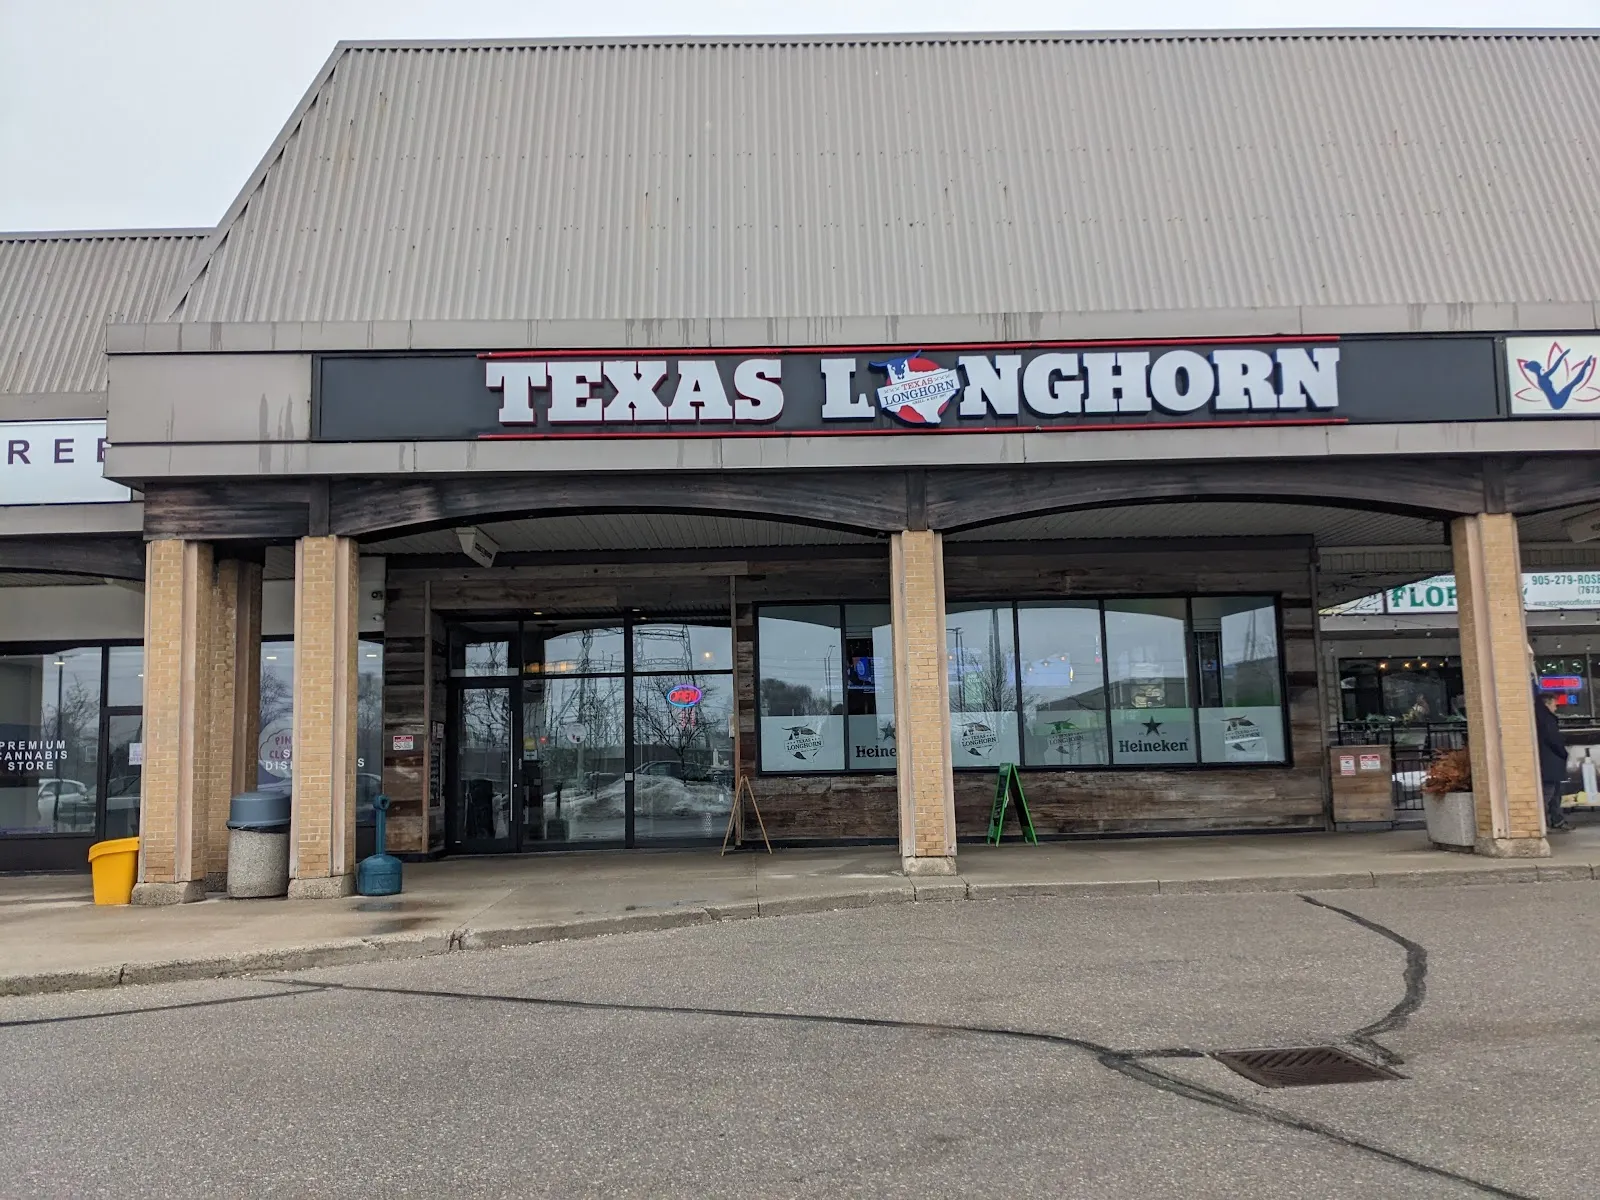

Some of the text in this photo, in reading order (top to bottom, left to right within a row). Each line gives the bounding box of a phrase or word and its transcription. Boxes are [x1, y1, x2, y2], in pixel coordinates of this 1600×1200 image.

[486, 348, 1340, 423] TEXAS LNGHORN
[901, 377, 934, 391] TEXAS
[883, 379, 955, 405] LONGHORN
[0, 740, 66, 750] PREMIUM
[786, 740, 822, 751] LONGHORN
[961, 736, 997, 747] LONGHORN
[1118, 740, 1188, 752] Heineken
[8, 760, 54, 771] STORE
